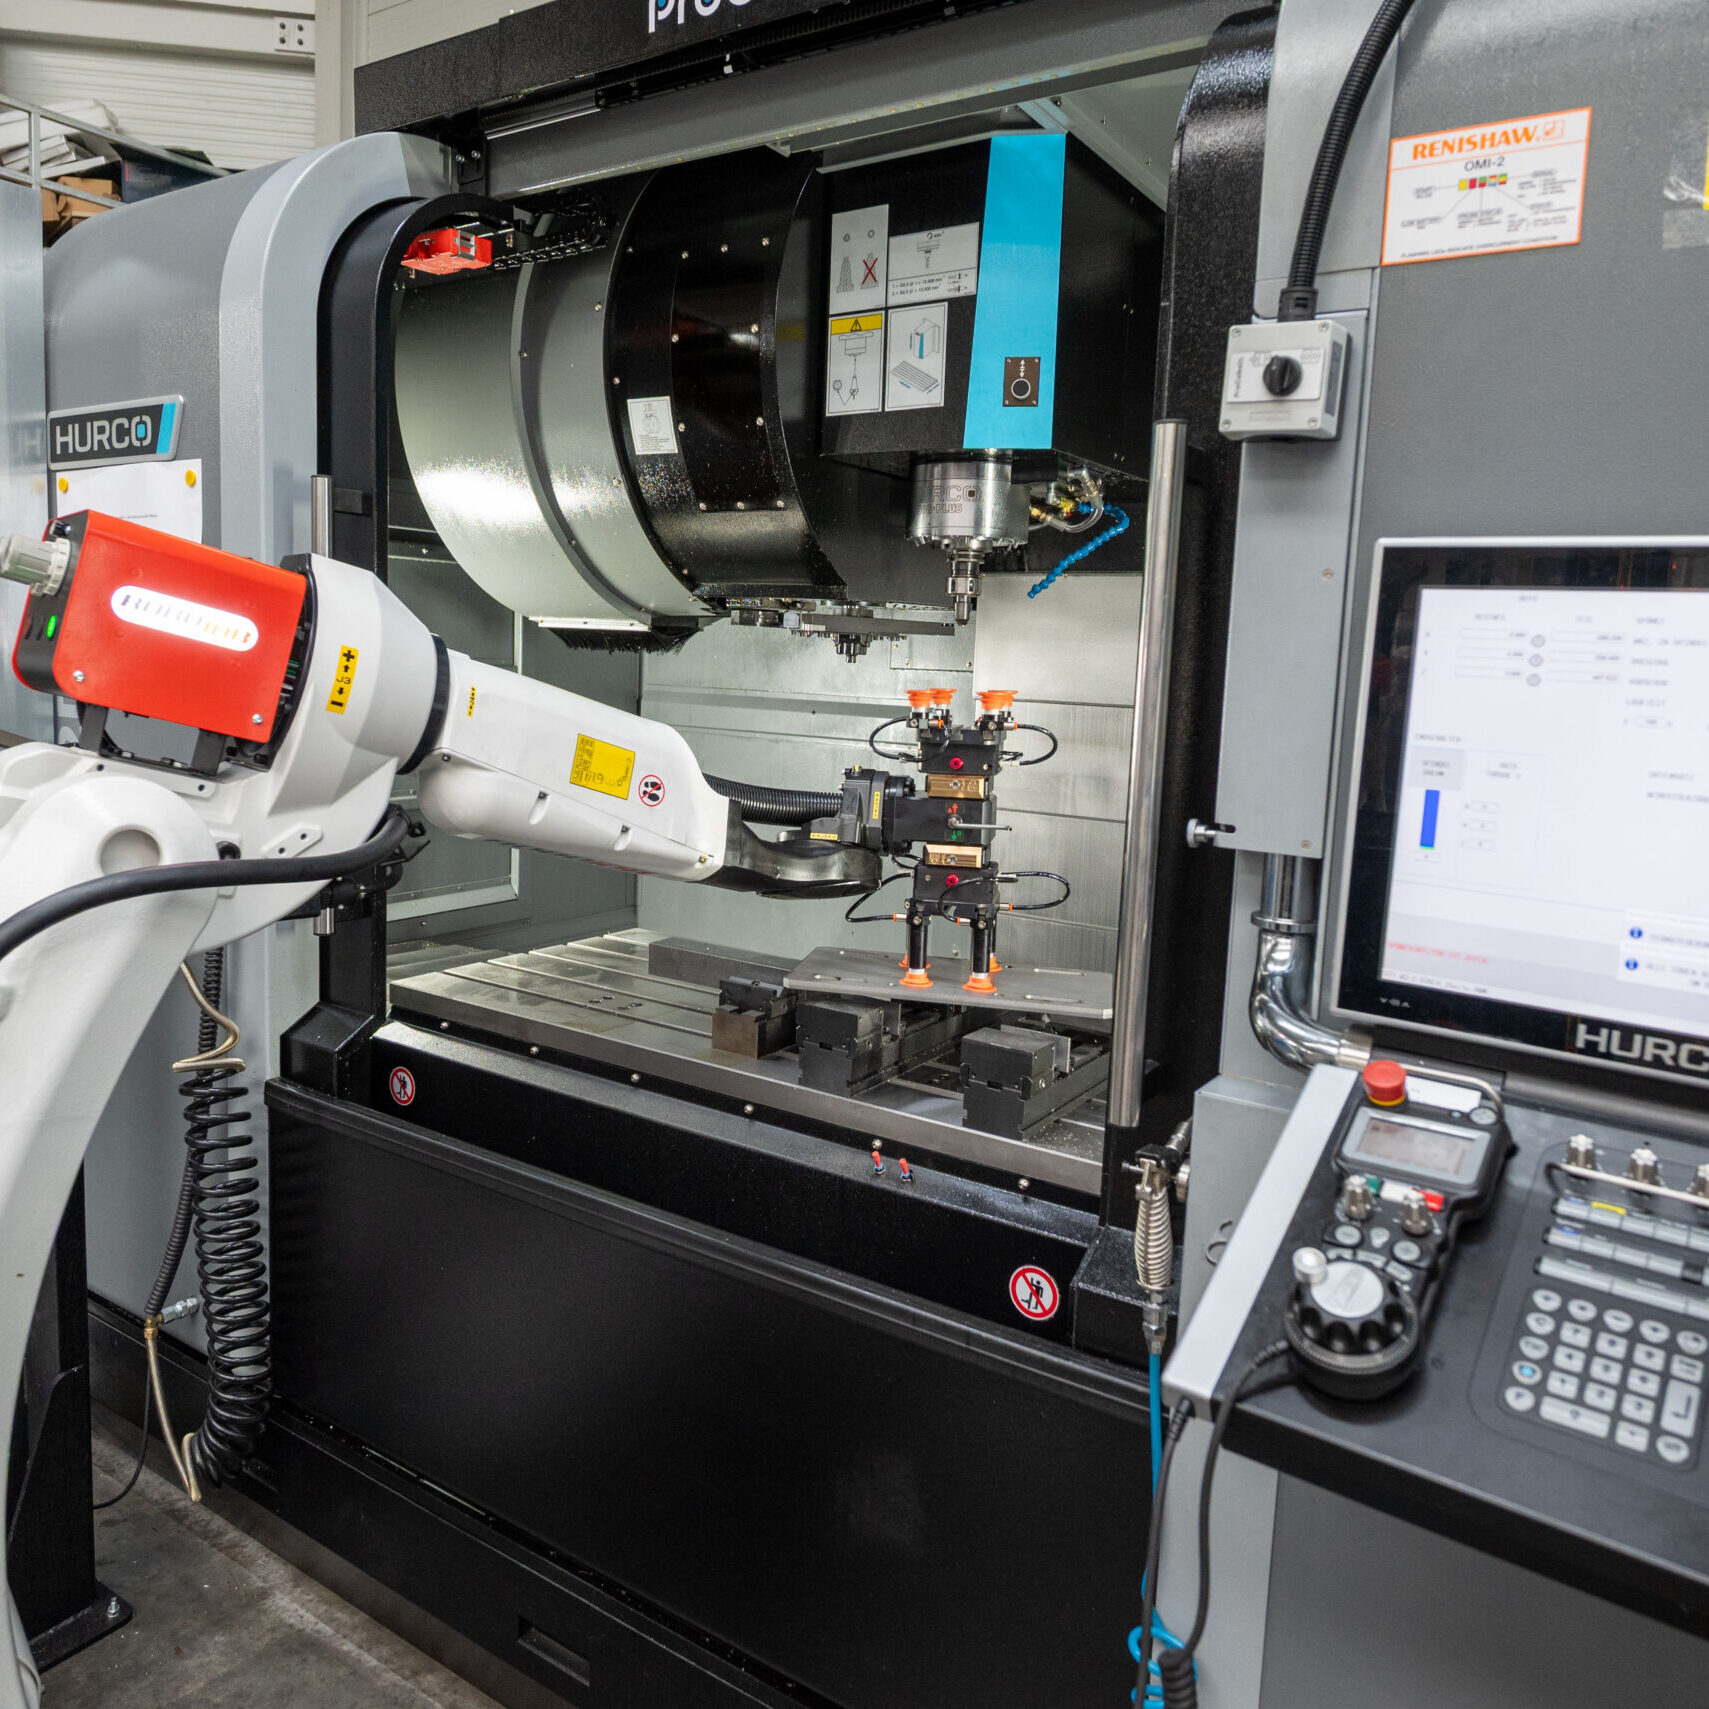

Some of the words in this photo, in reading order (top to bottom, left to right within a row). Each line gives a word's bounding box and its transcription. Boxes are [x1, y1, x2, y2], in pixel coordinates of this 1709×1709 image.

[1412, 124, 1538, 160] RENISHAW
[1464, 156, 1505, 172] OMI-2
[55, 414, 152, 455] HURCO
[336, 676, 352, 685] J3
